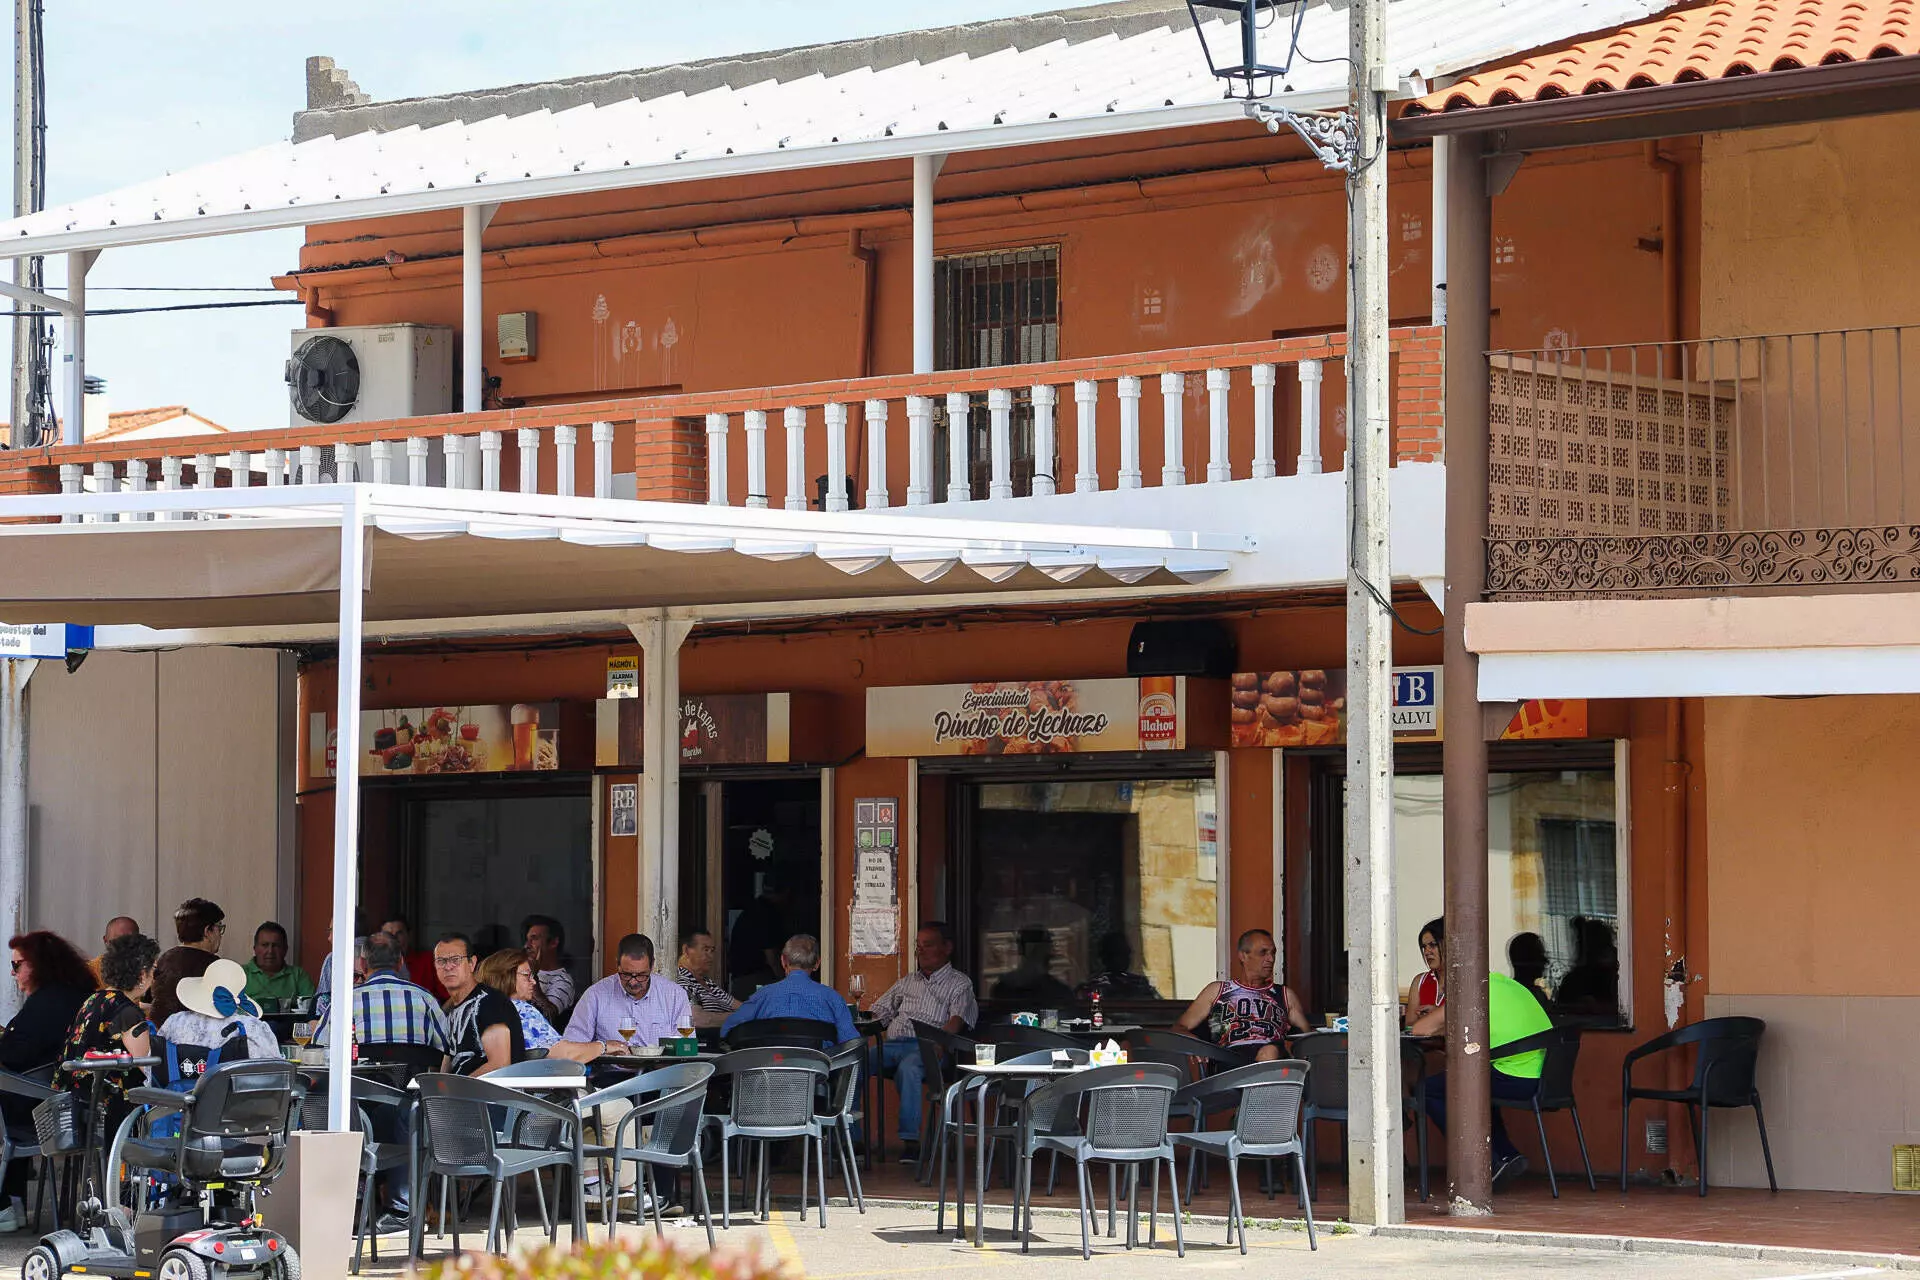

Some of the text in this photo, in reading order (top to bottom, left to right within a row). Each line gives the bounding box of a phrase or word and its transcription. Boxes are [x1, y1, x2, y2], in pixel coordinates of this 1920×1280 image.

[33, 625, 46, 635] del
[1405, 675, 1427, 703] B
[962, 690, 1029, 711] Especialidad
[685, 700, 696, 716] de
[697, 702, 718, 739] tapas
[934, 707, 1108, 743] Pincho de Lechazo
[1141, 718, 1174, 732] Mahou
[613, 789, 635, 809] RB
